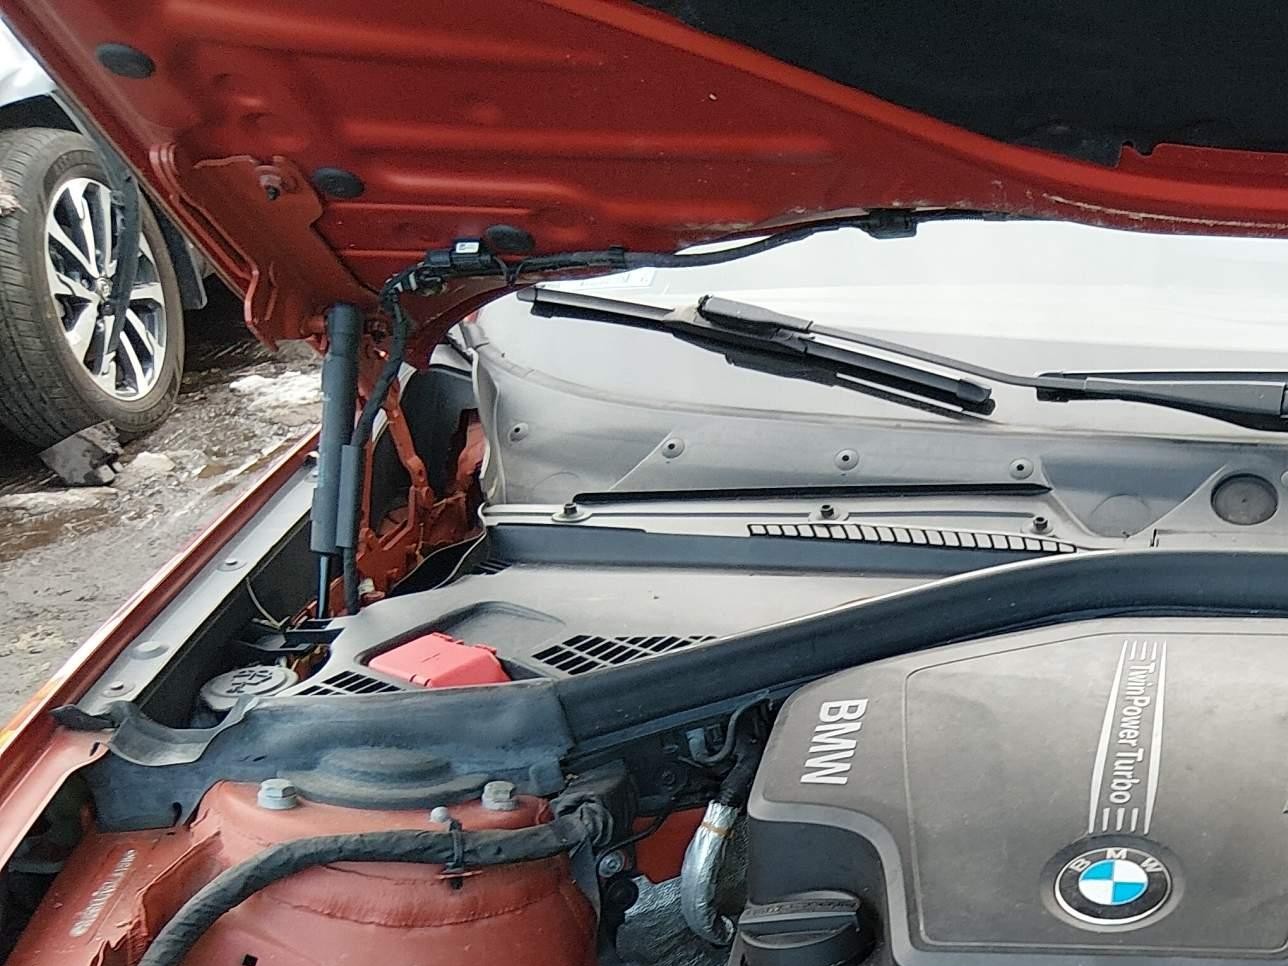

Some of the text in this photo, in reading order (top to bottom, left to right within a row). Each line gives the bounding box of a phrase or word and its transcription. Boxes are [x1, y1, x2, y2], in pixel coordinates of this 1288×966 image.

[800, 699, 869, 785] BMW
[1109, 662, 1156, 804] TwinPower Turbo
[1069, 847, 1163, 873] BMW
